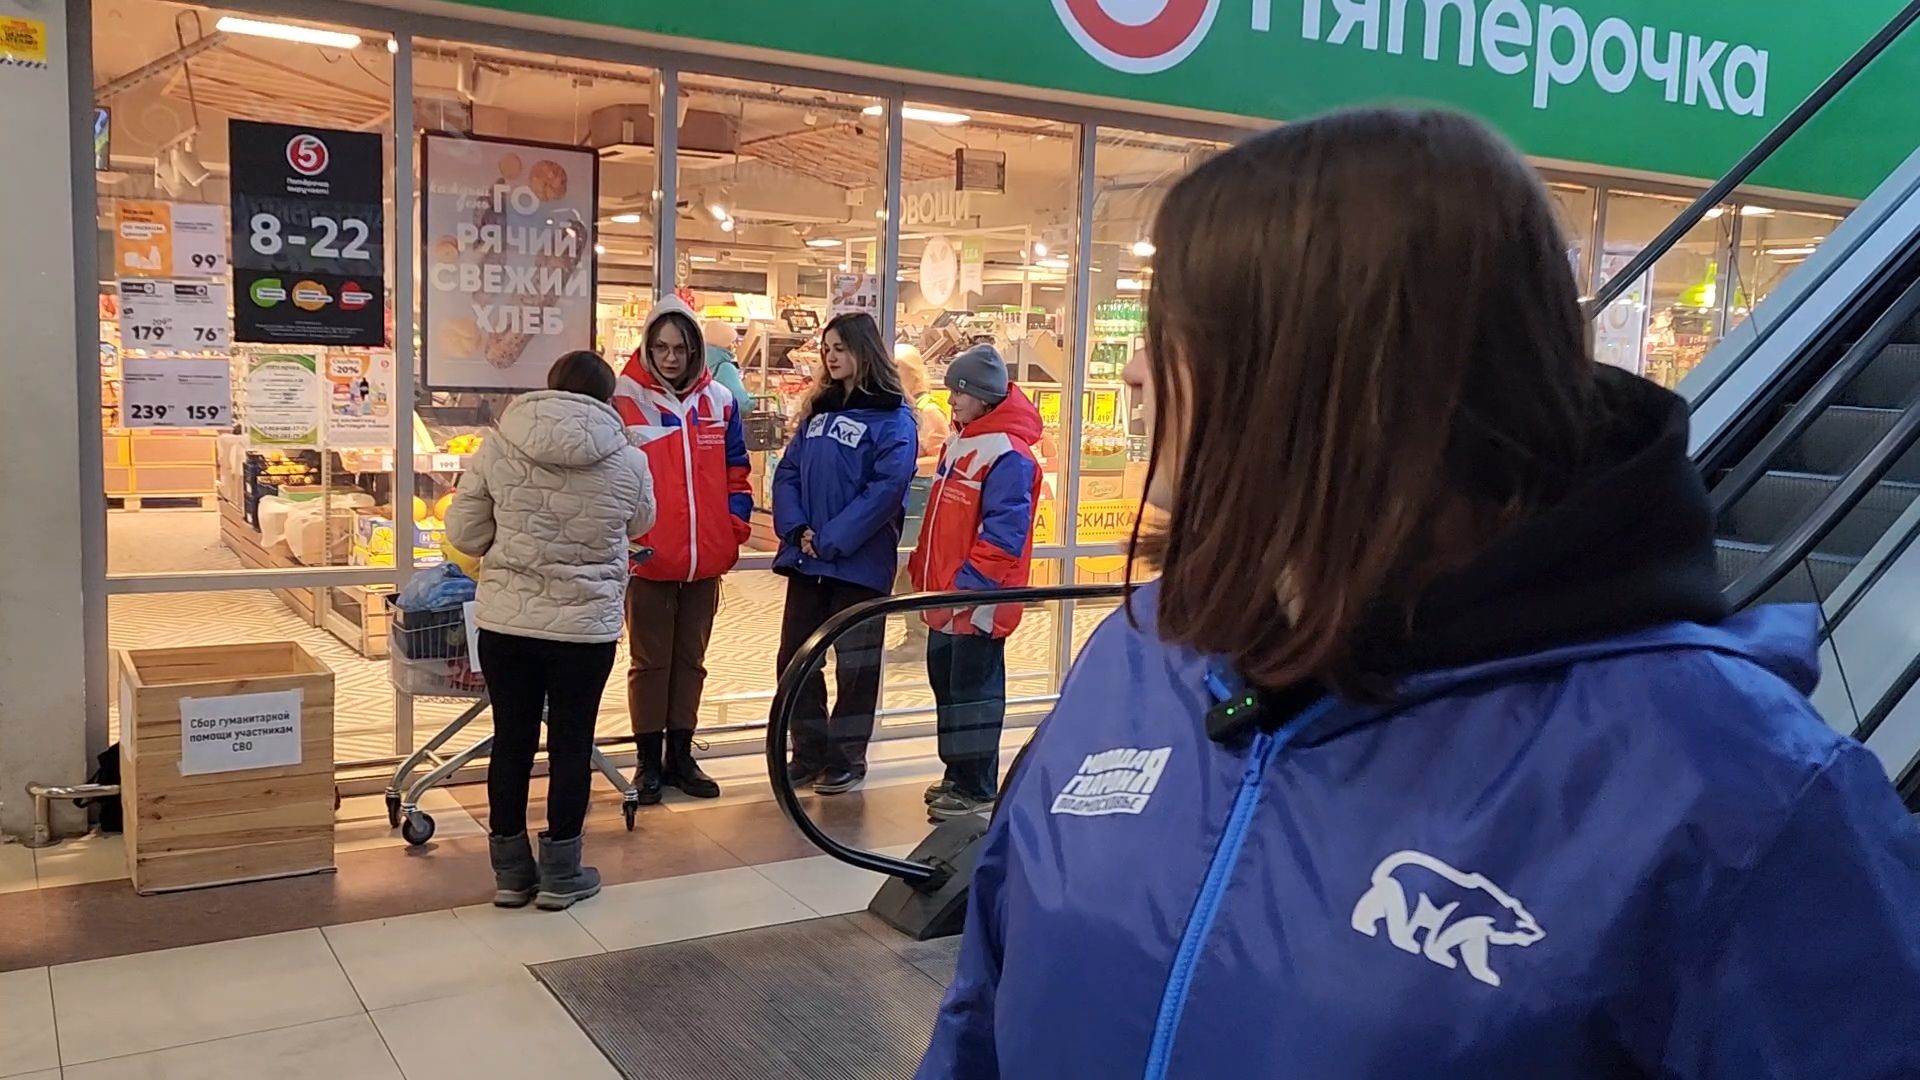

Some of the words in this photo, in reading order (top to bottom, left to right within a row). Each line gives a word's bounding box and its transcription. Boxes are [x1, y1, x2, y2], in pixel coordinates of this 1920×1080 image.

[493, 184, 540, 215] ГО
[250, 213, 370, 260] 8-22
[191, 254, 216, 268] 99
[472, 304, 565, 335] ХЛЕБ
[131, 325, 165, 340] 179
[193, 327, 217, 341] 76
[333, 366, 359, 374] -20%
[131, 404, 167, 419] 239
[186, 405, 219, 419] 159
[1075, 511, 1137, 530] СКИДКА
[190, 718, 216, 729] Сбор
[219, 710, 290, 727] гуманитарной
[189, 732, 232, 742] помощи
[234, 726, 293, 740] участникам
[232, 741, 253, 752] СВО
